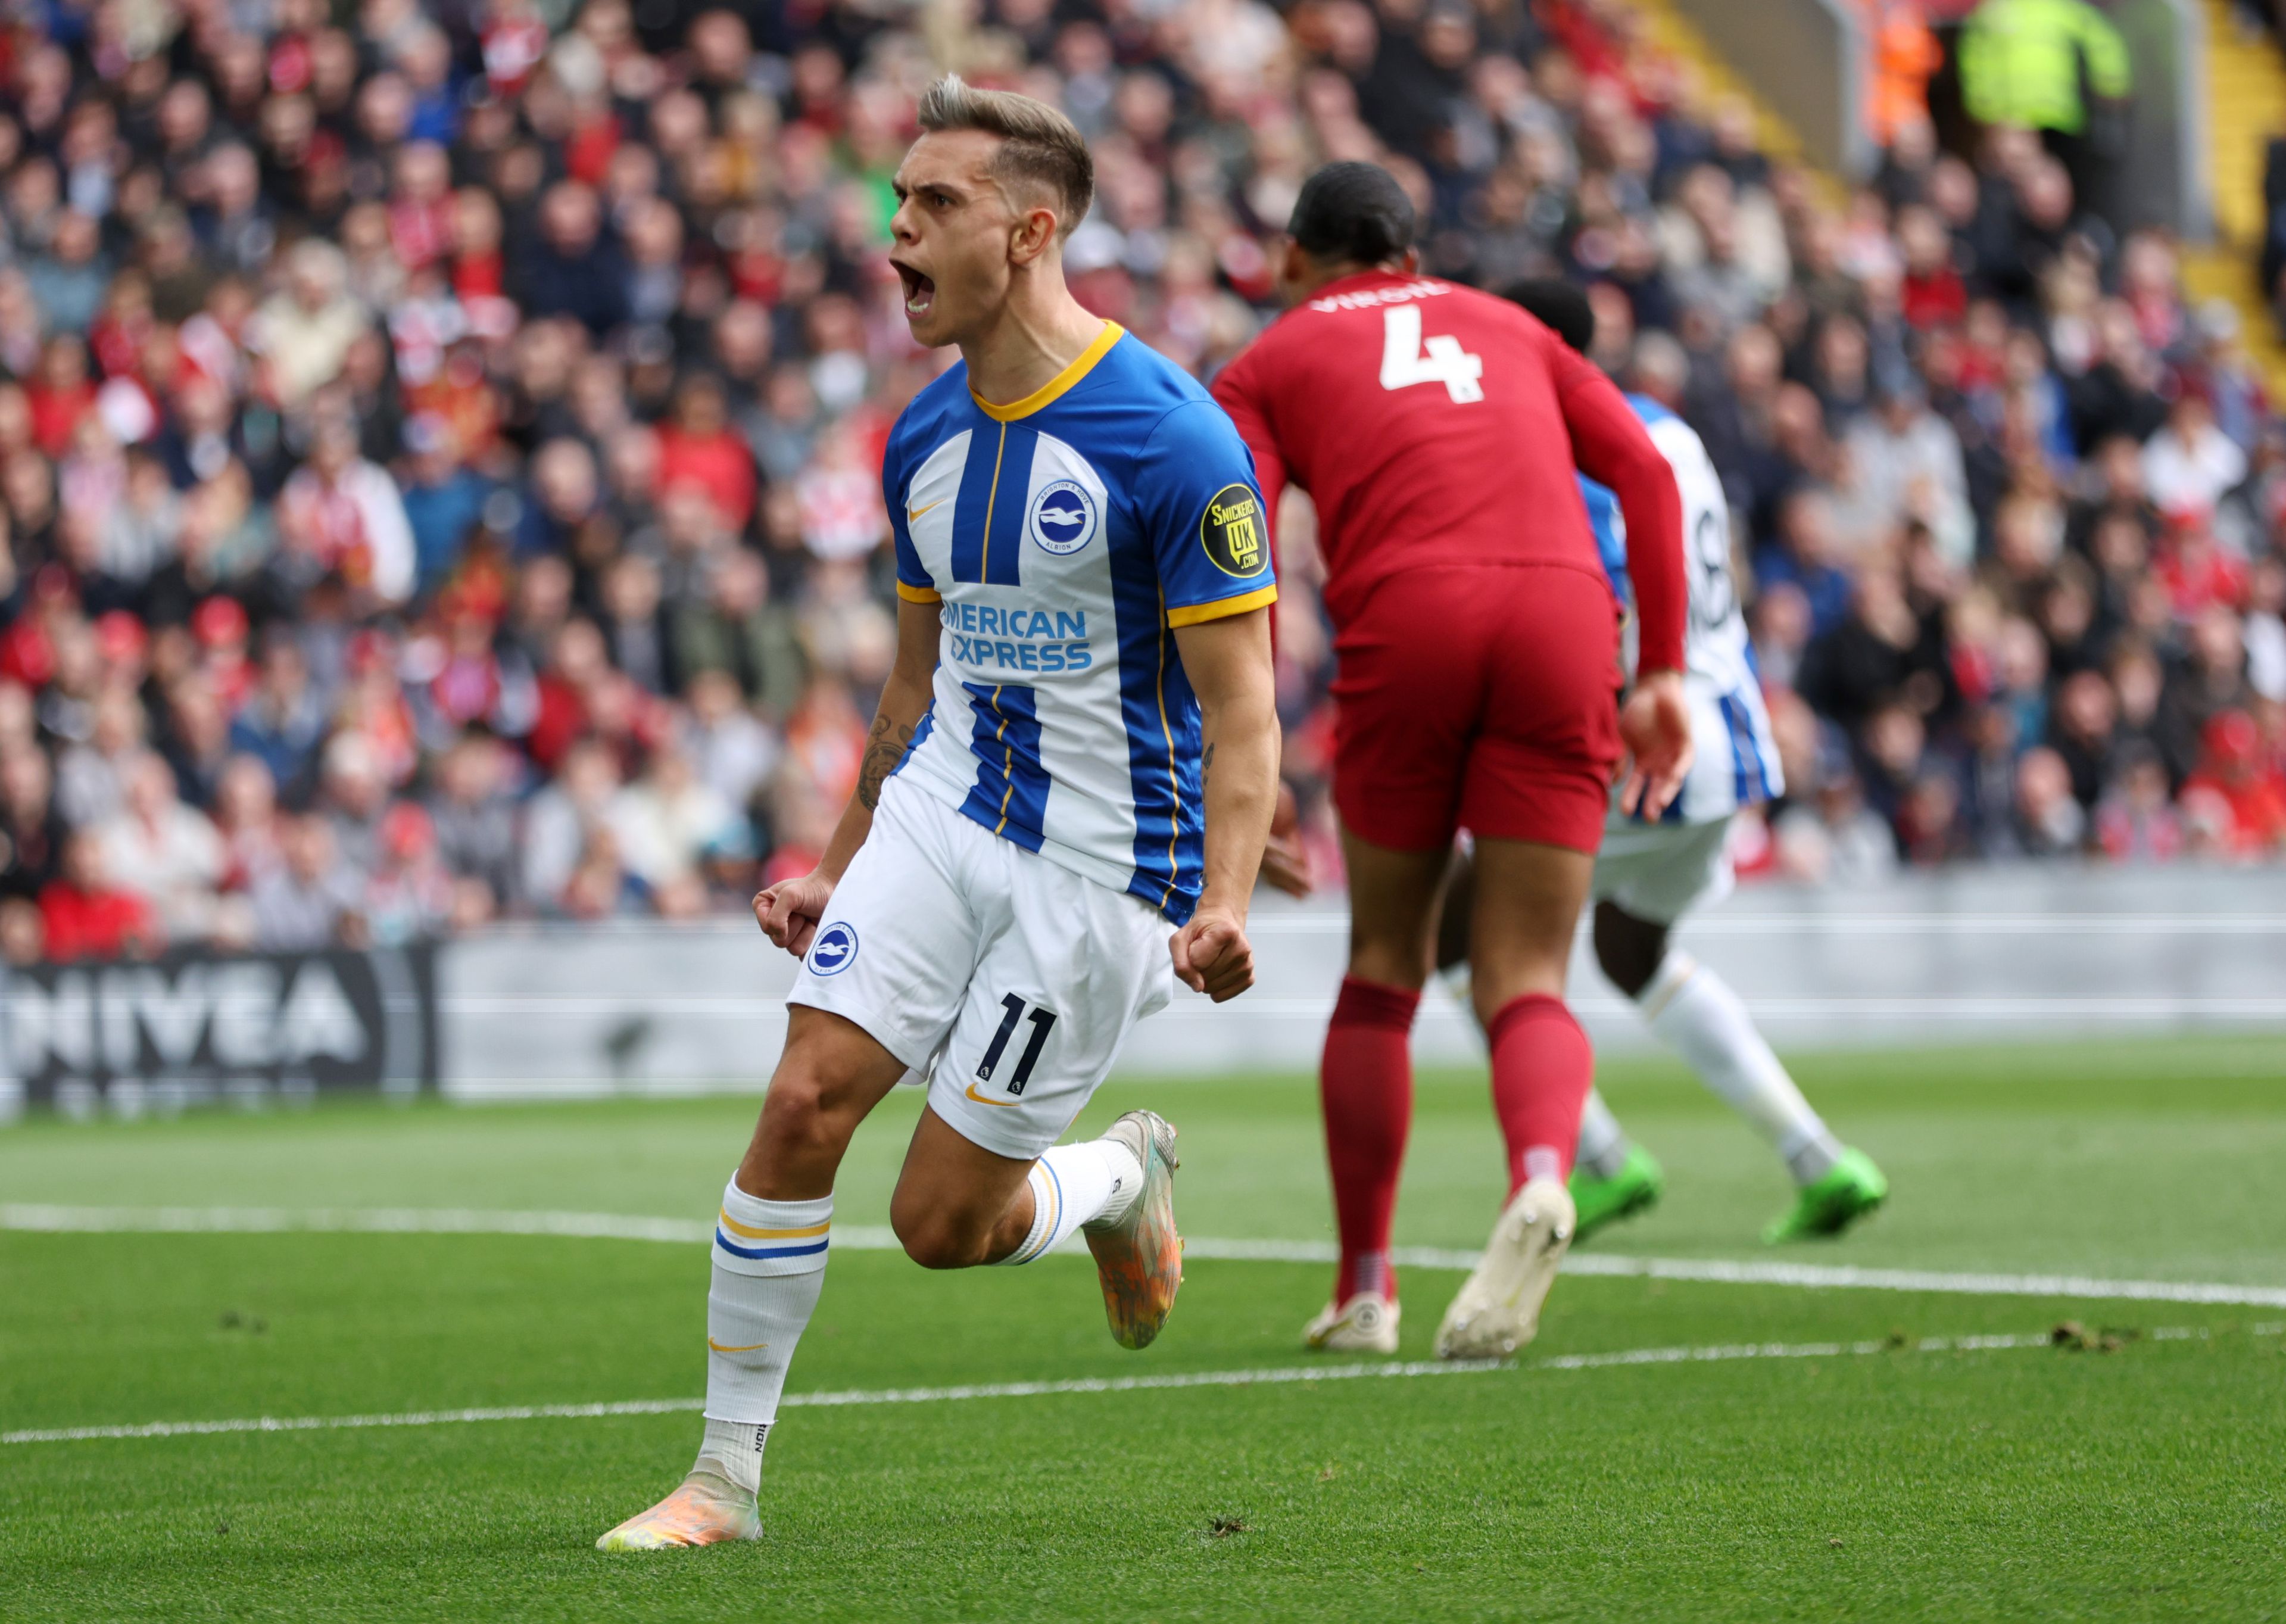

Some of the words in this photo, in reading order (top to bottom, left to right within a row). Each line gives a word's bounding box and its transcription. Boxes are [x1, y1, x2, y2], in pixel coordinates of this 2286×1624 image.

[1379, 303, 1485, 404] 4
[1040, 483, 1069, 501] BRIGHTON
[1077, 488, 1090, 505] HOVE
[1046, 542, 1071, 551] ALBION
[1230, 522, 1253, 552] UK
[1241, 553, 1259, 570] .COM
[0, 958, 368, 1074] NIVEA
[975, 992, 1058, 1096] 11
